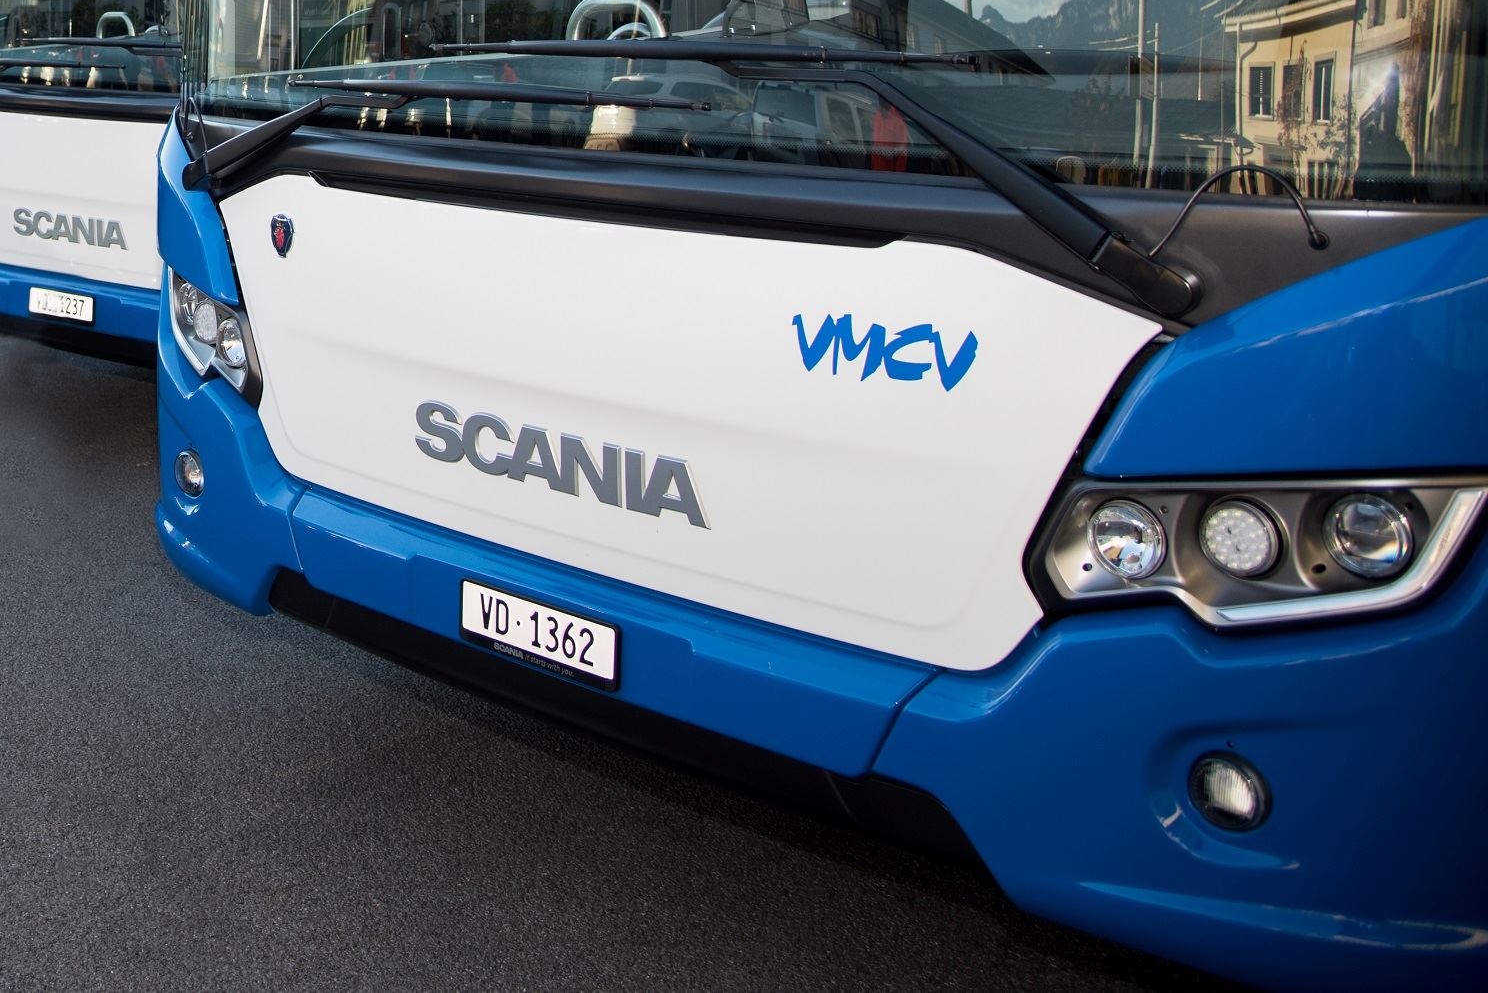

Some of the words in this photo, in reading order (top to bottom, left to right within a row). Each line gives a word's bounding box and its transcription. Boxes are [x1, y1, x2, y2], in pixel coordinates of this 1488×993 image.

[13, 206, 129, 251] SCANIA
[792, 314, 979, 392] VMCV
[414, 399, 712, 531] SCANIA
[493, 641, 524, 660] SCANIA
